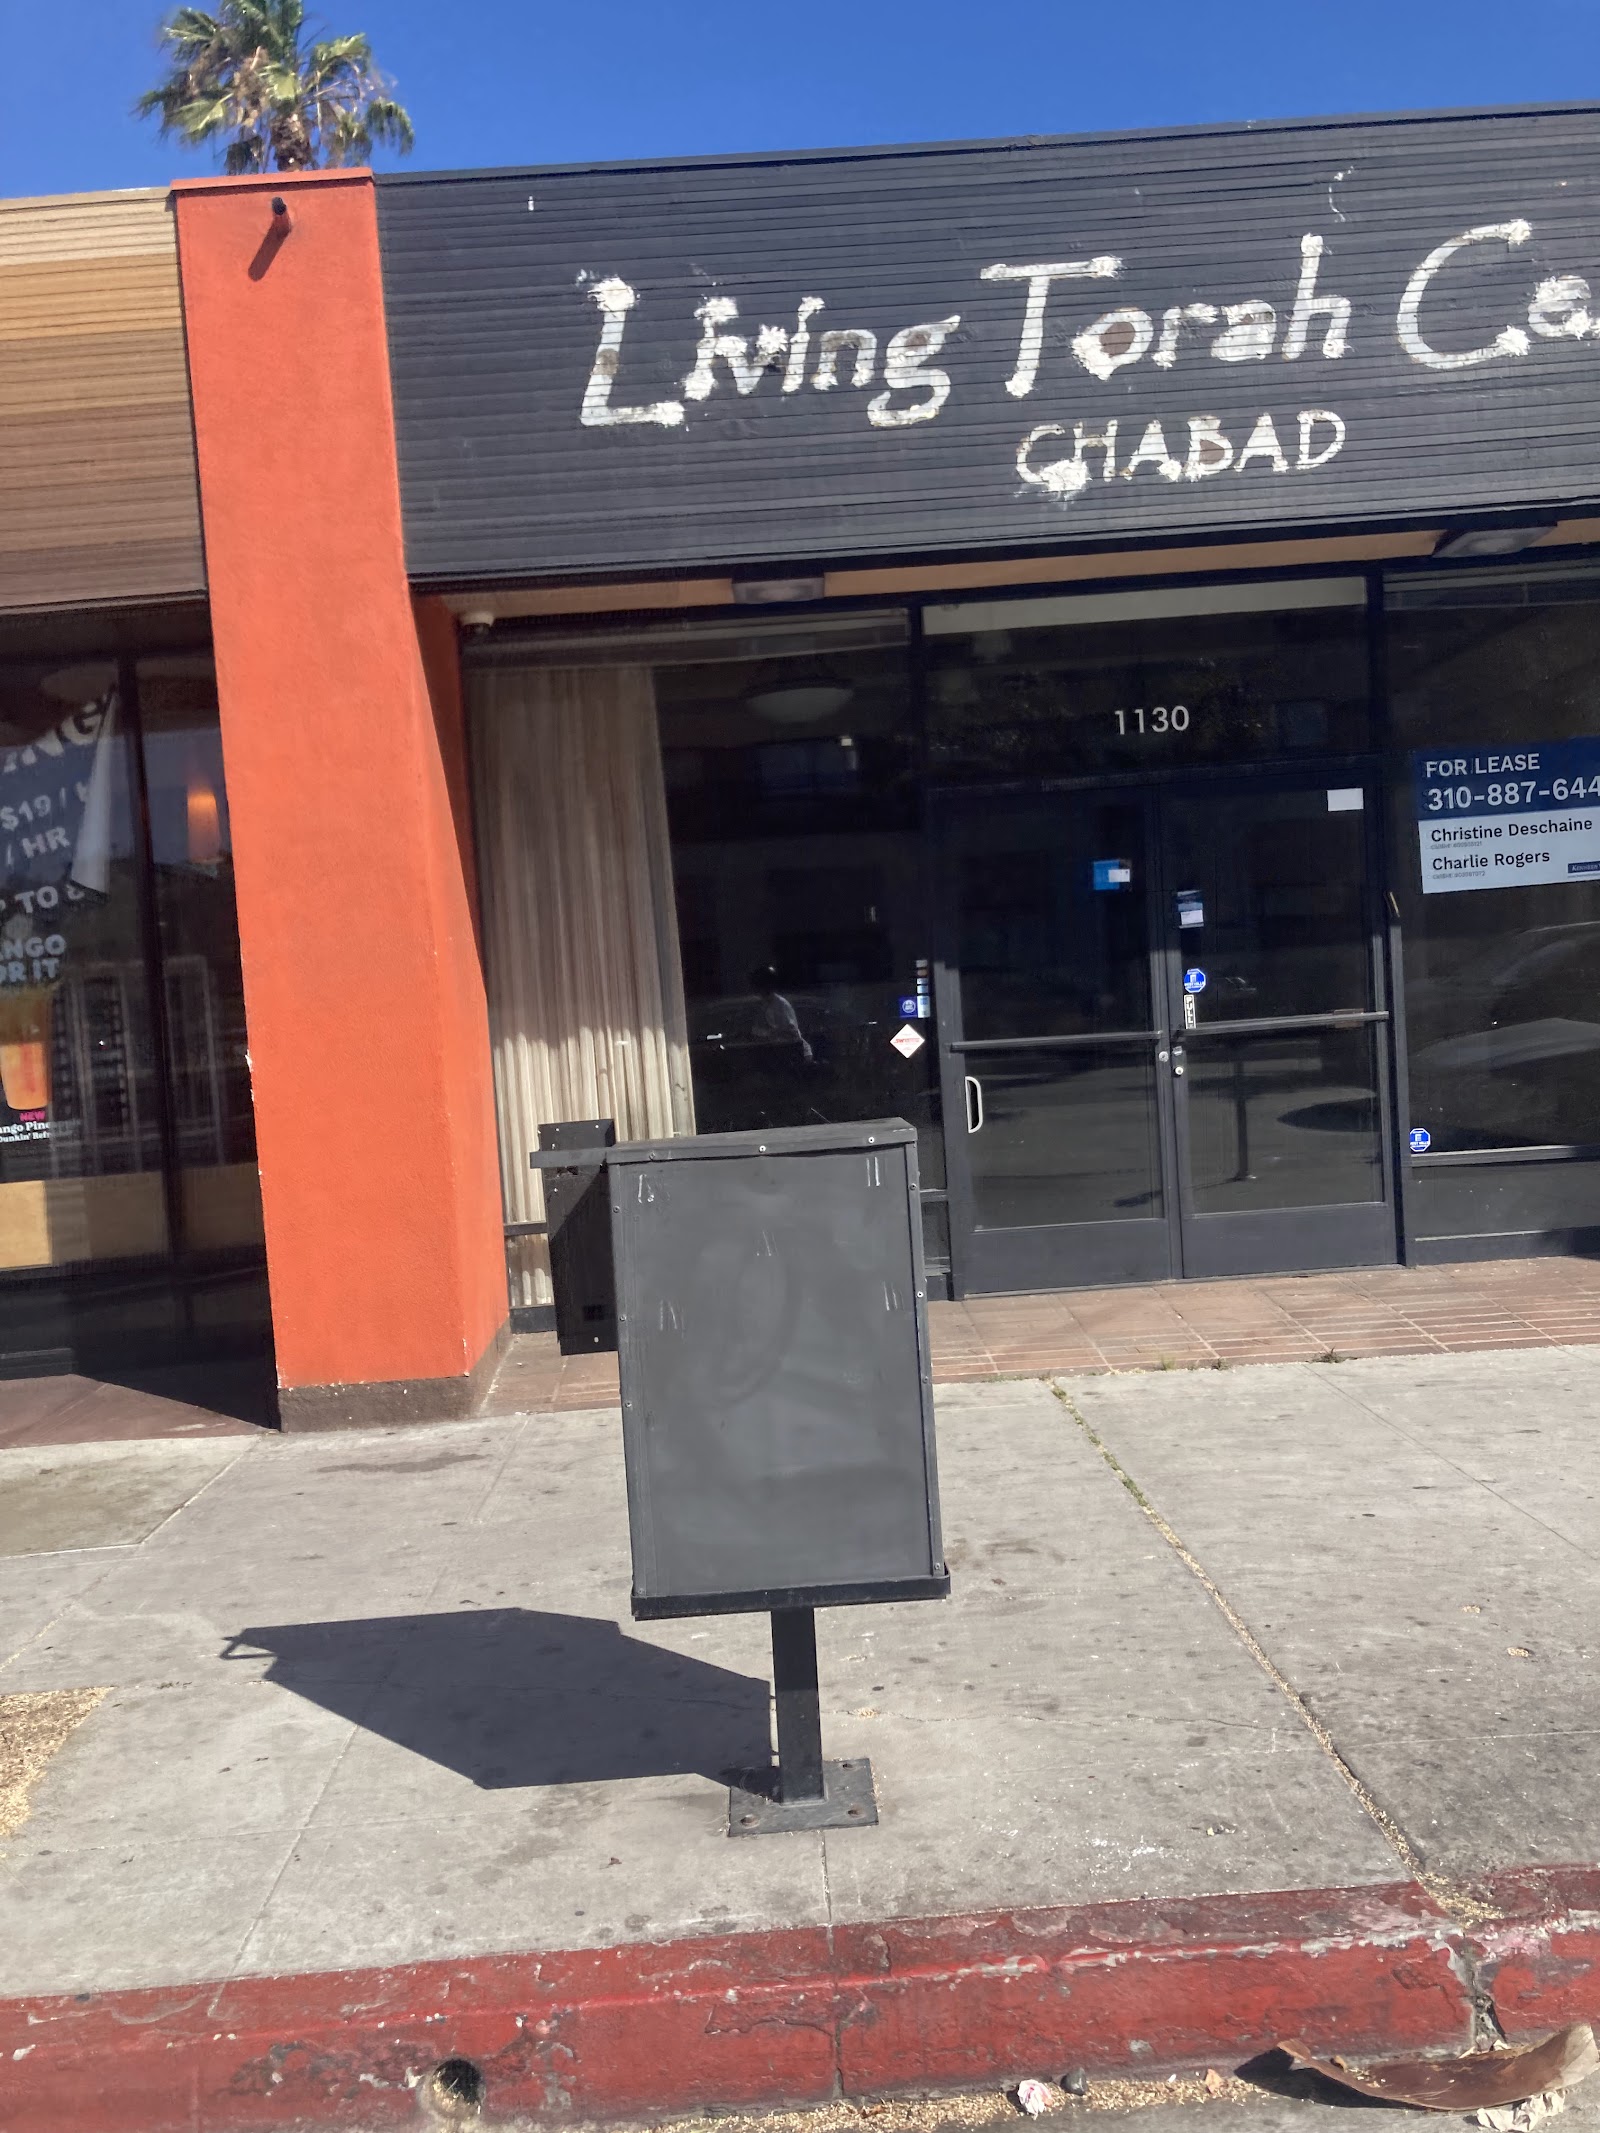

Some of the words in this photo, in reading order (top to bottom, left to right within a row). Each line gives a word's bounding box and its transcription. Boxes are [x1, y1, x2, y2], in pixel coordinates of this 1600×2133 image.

[580, 277, 961, 427] Living
[980, 234, 1351, 397] Torah
[1398, 219, 1600, 369] Ce
[1016, 410, 1346, 490] CHABAD
[1114, 705, 1190, 735] 1130
[1425, 759, 1468, 778] FOR
[1475, 753, 1540, 774] LEASE
[1431, 825, 1502, 842] Christine
[1509, 818, 1592, 836] Deschaine
[1432, 854, 1488, 870] Charlie
[1495, 852, 1550, 867] Rogers
[0, 934, 67, 960] NGO
[20, 1110, 46, 1122] NEW
